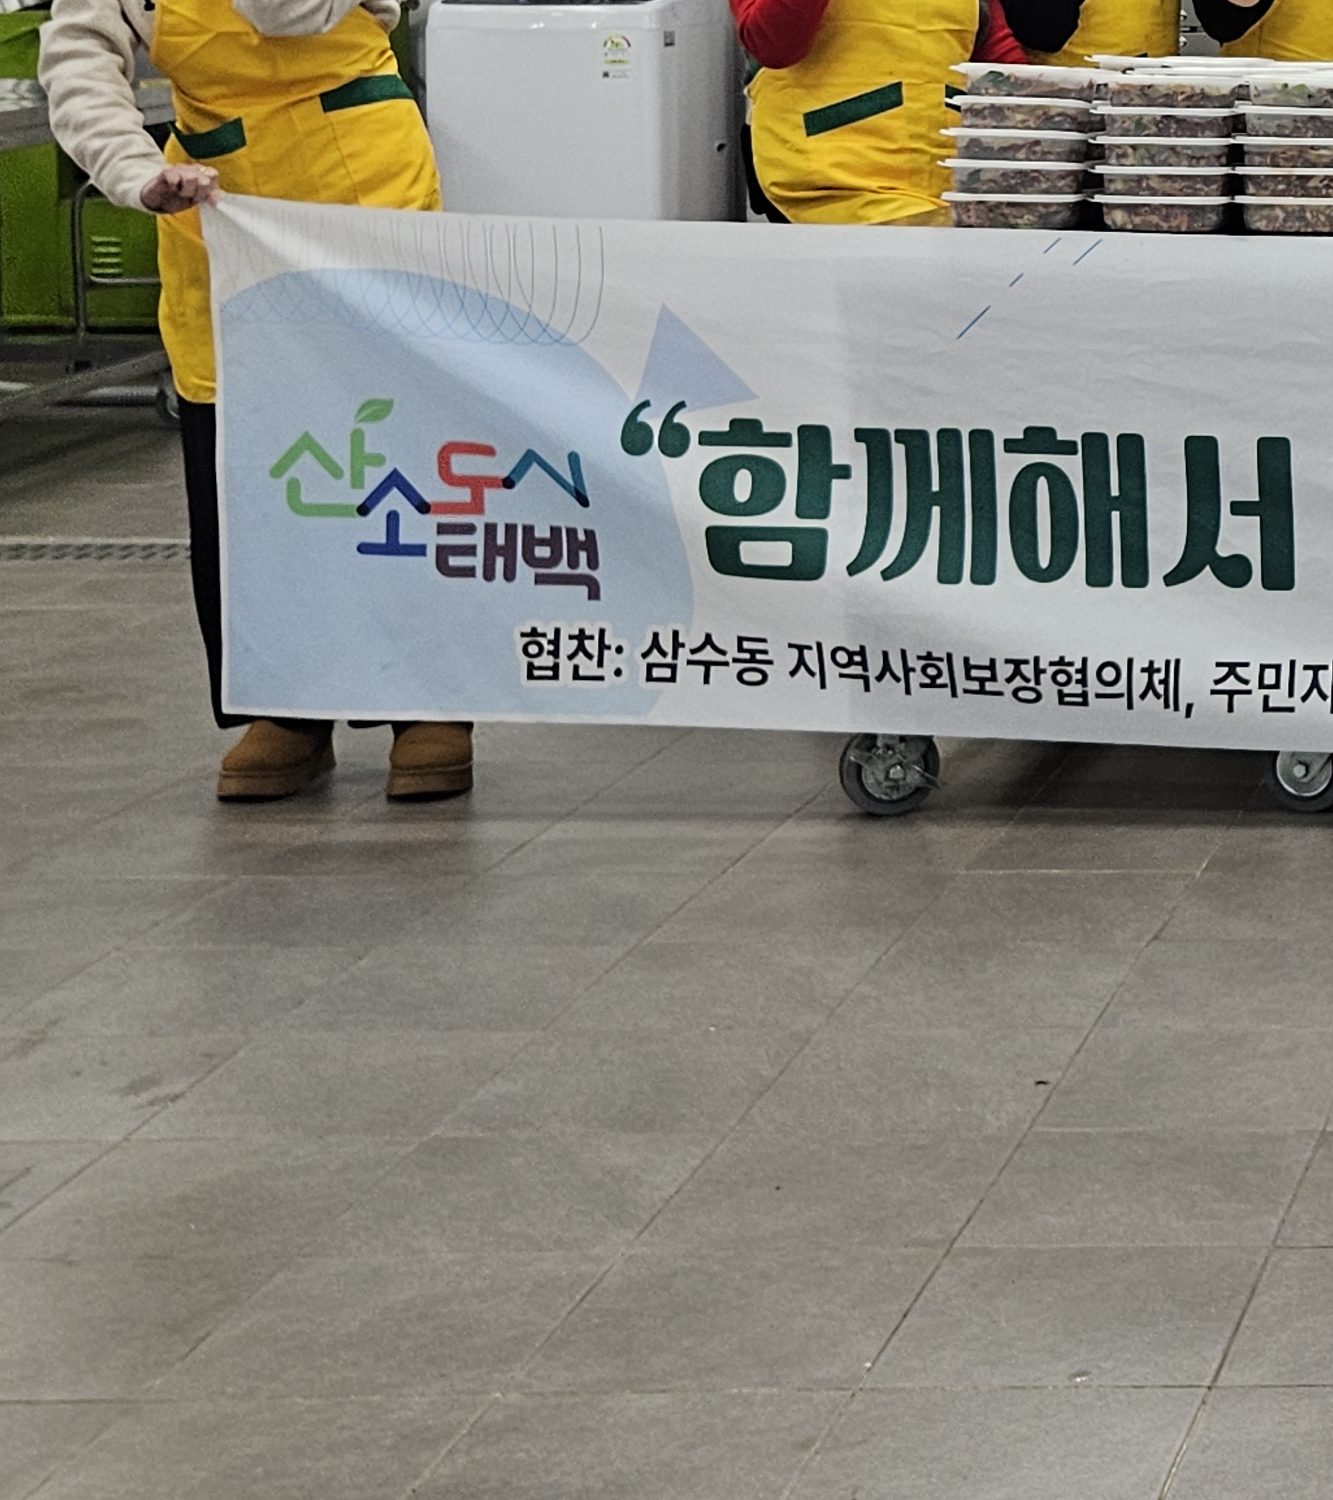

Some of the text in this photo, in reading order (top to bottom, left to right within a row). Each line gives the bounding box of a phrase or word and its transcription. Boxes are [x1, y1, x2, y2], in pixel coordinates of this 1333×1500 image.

[619, 398, 1297, 592] “함께해서
[434, 520, 601, 601] 태백
[519, 625, 626, 683] 협찬:
[639, 629, 775, 687] 삼수동
[787, 640, 1195, 719] 지역사회보장협의체,
